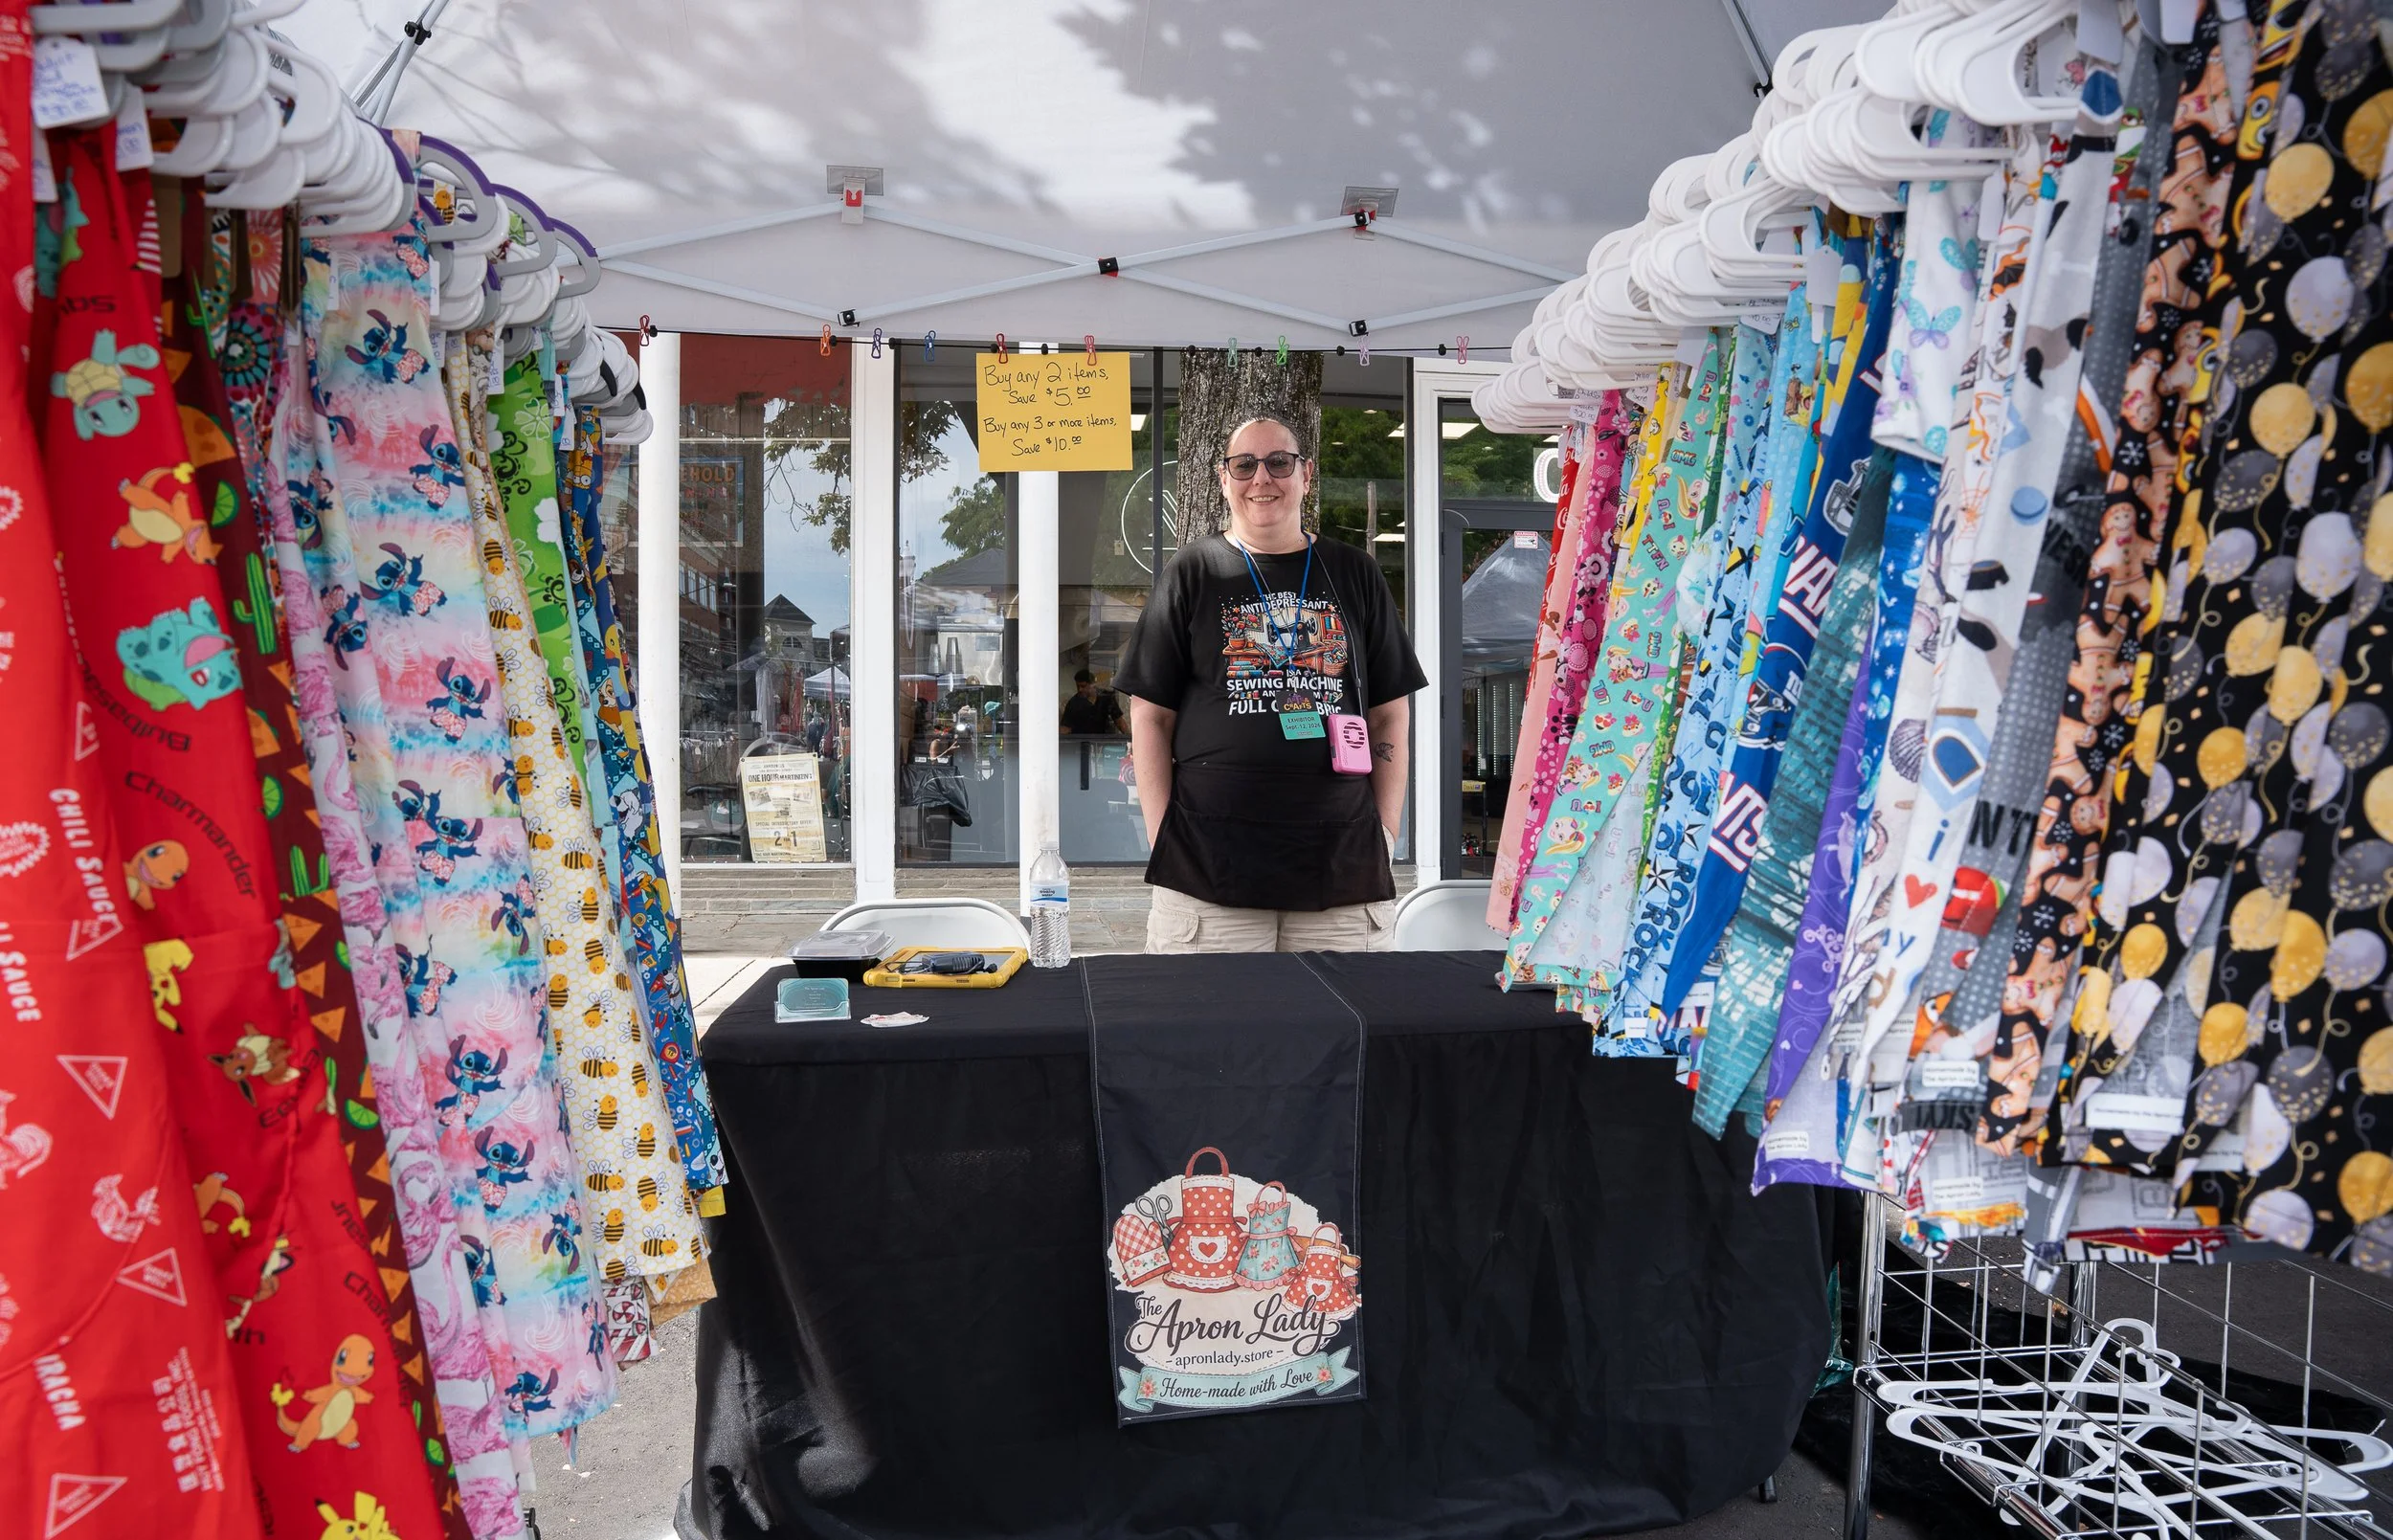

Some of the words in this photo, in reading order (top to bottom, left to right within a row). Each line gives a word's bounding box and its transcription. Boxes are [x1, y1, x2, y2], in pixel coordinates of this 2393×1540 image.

[984, 364, 1012, 391] Buy
[1016, 369, 1040, 389] any
[1045, 362, 1062, 382] 2
[1067, 363, 1109, 380] items,
[1008, 391, 1038, 405] Save
[983, 416, 1007, 438] Buy
[1010, 422, 1030, 434] any
[1033, 415, 1043, 430] 3
[1059, 418, 1084, 428] more
[1086, 413, 1117, 427] items,
[1011, 437, 1041, 457] Save
[1241, 598, 1329, 614] ANTIDEPRESSANT
[1278, 591, 1296, 600] BEST
[1227, 678, 1283, 691] SEWING
[1286, 677, 1343, 692] MACHINE
[1229, 700, 1267, 715] FULL
[761, 773, 780, 782] HOUR
[50, 788, 94, 849] CHILI
[124, 770, 257, 900] Charmander
[773, 831, 782, 846] 2
[1135, 1295, 1162, 1319] The
[1126, 1298, 1244, 1356] Apron
[1245, 1293, 1341, 1357] Lady
[1159, 1376, 1245, 1398] Home-made
[1249, 1377, 1278, 1396] with
[1281, 1369, 1314, 1389] Love
